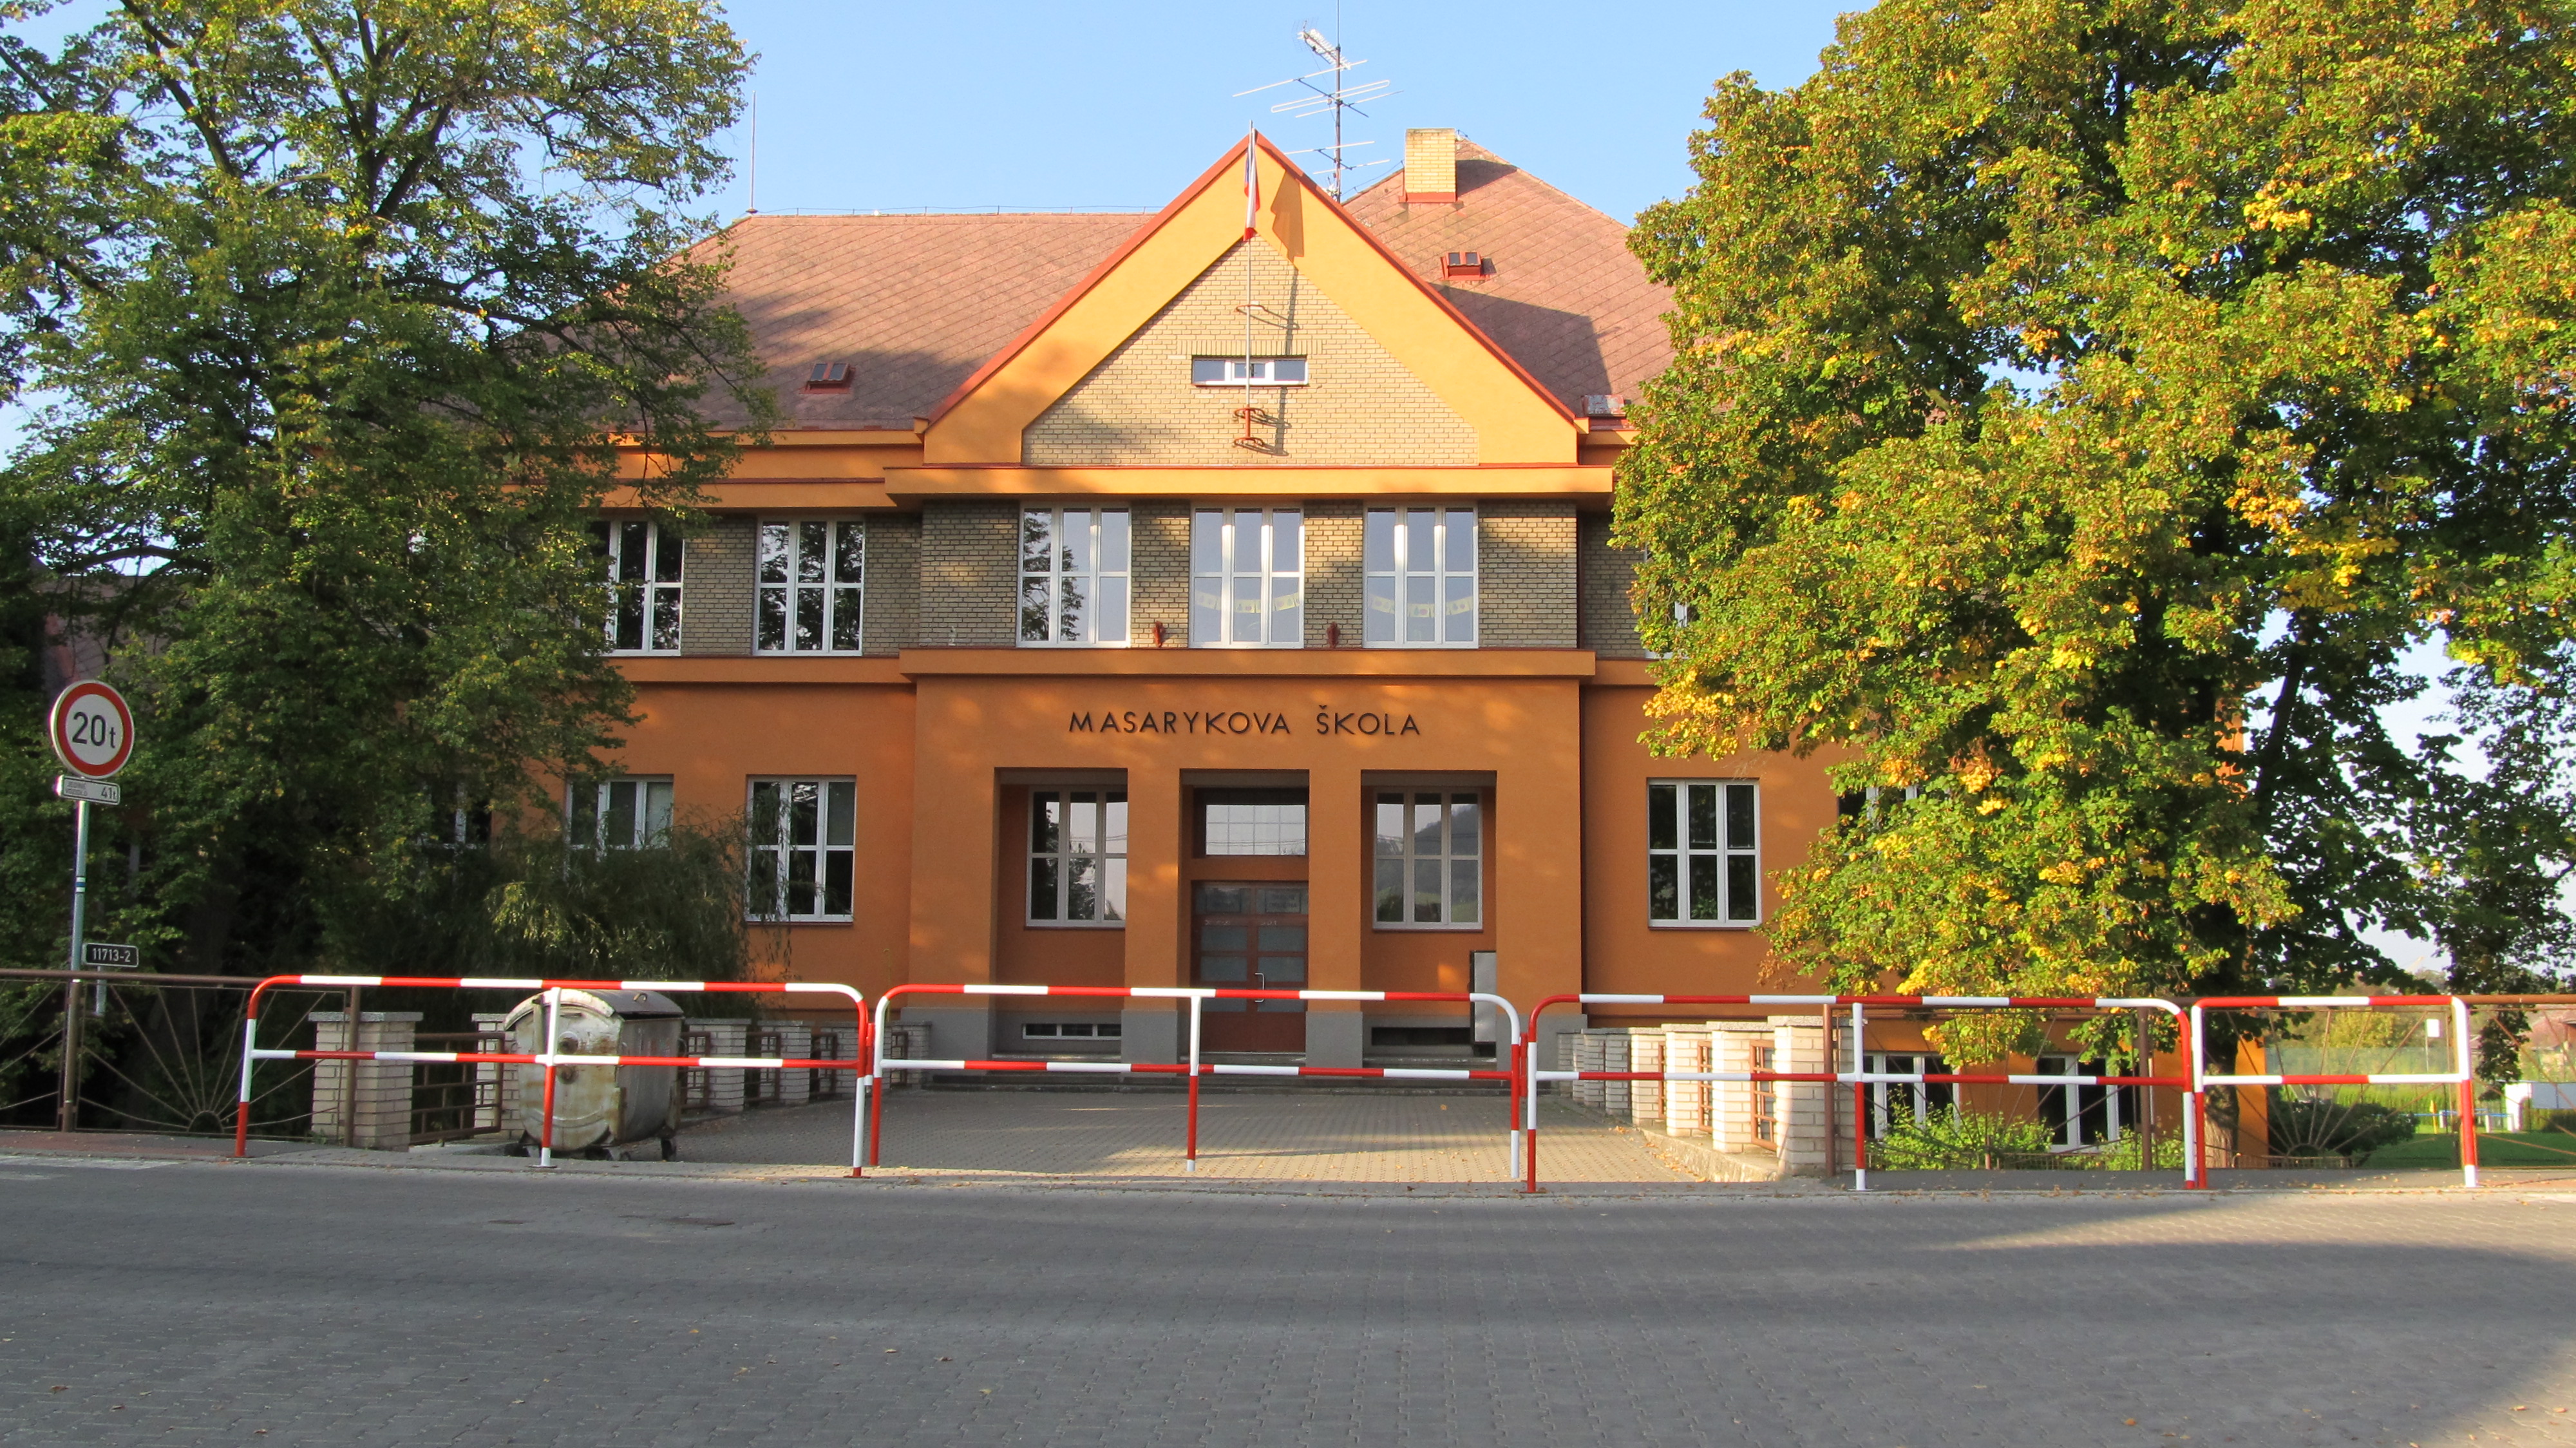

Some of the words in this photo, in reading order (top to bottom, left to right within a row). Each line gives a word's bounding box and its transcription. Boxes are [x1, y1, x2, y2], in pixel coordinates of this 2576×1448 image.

[1069, 711, 1290, 734] MASARYKOVA
[1316, 705, 1420, 735] ŠKOLA
[93, 948, 131, 962] 11713-2
